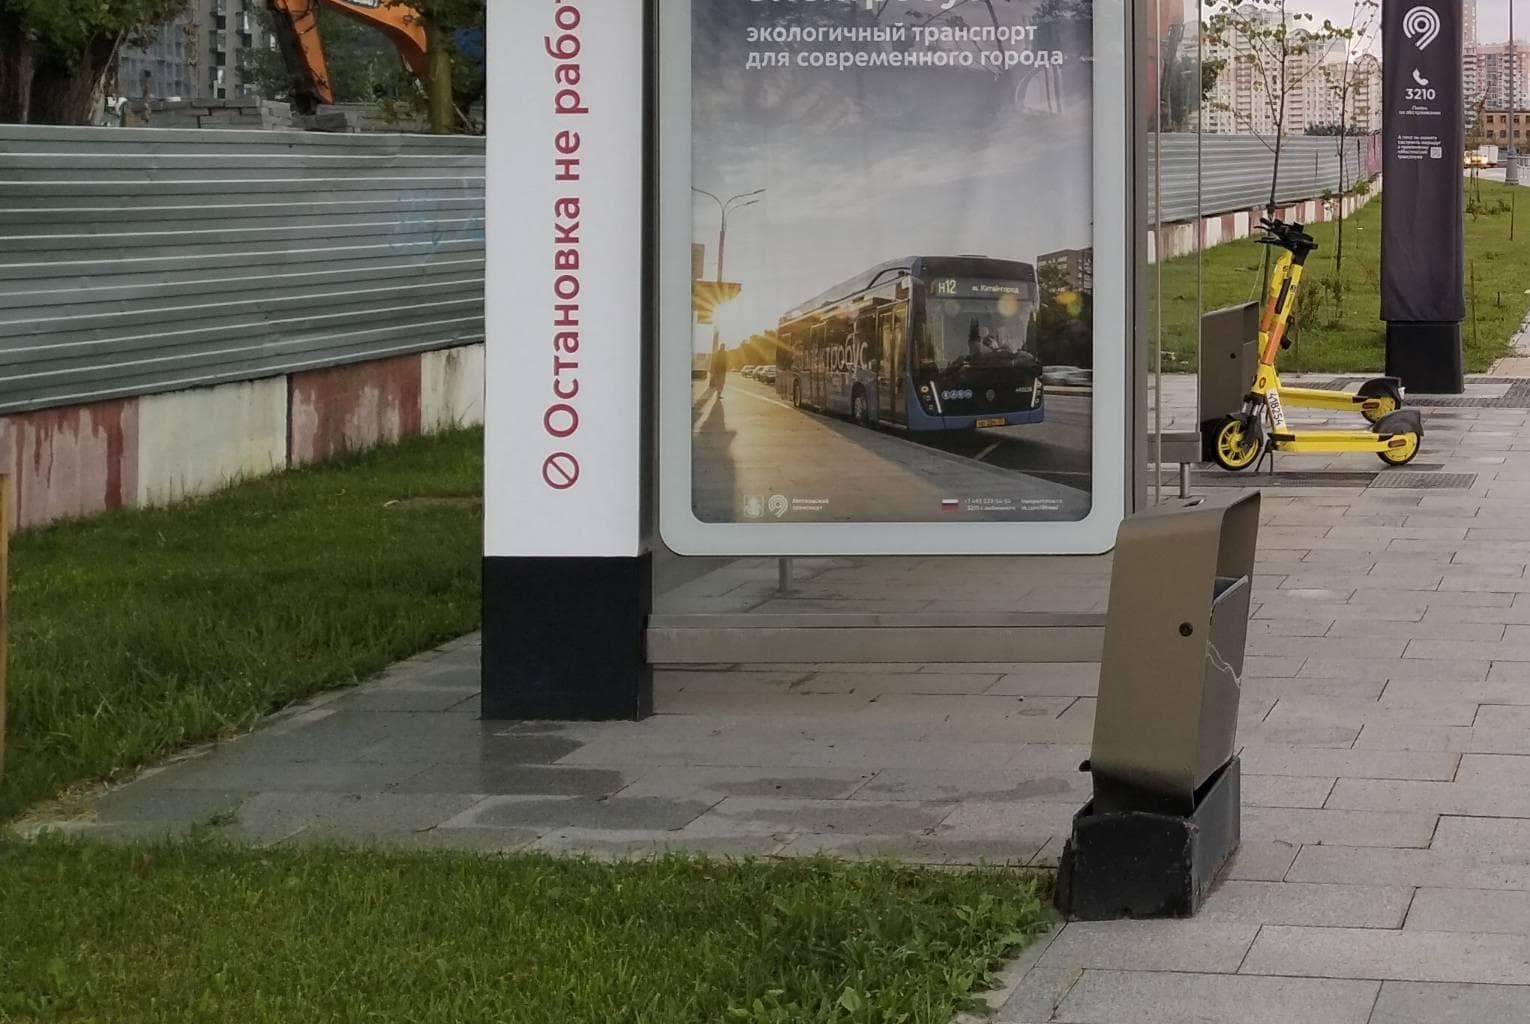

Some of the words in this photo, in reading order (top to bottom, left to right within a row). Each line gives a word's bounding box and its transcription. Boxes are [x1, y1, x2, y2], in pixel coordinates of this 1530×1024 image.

[746, 22, 906, 42] экологичный
[912, 25, 1038, 45] транспорт
[745, 50, 790, 69] для
[797, 50, 974, 70] современного
[980, 49, 1064, 68] города
[1405, 88, 1436, 101] 3210
[555, 130, 580, 180] не
[543, 196, 580, 438] Остановка
